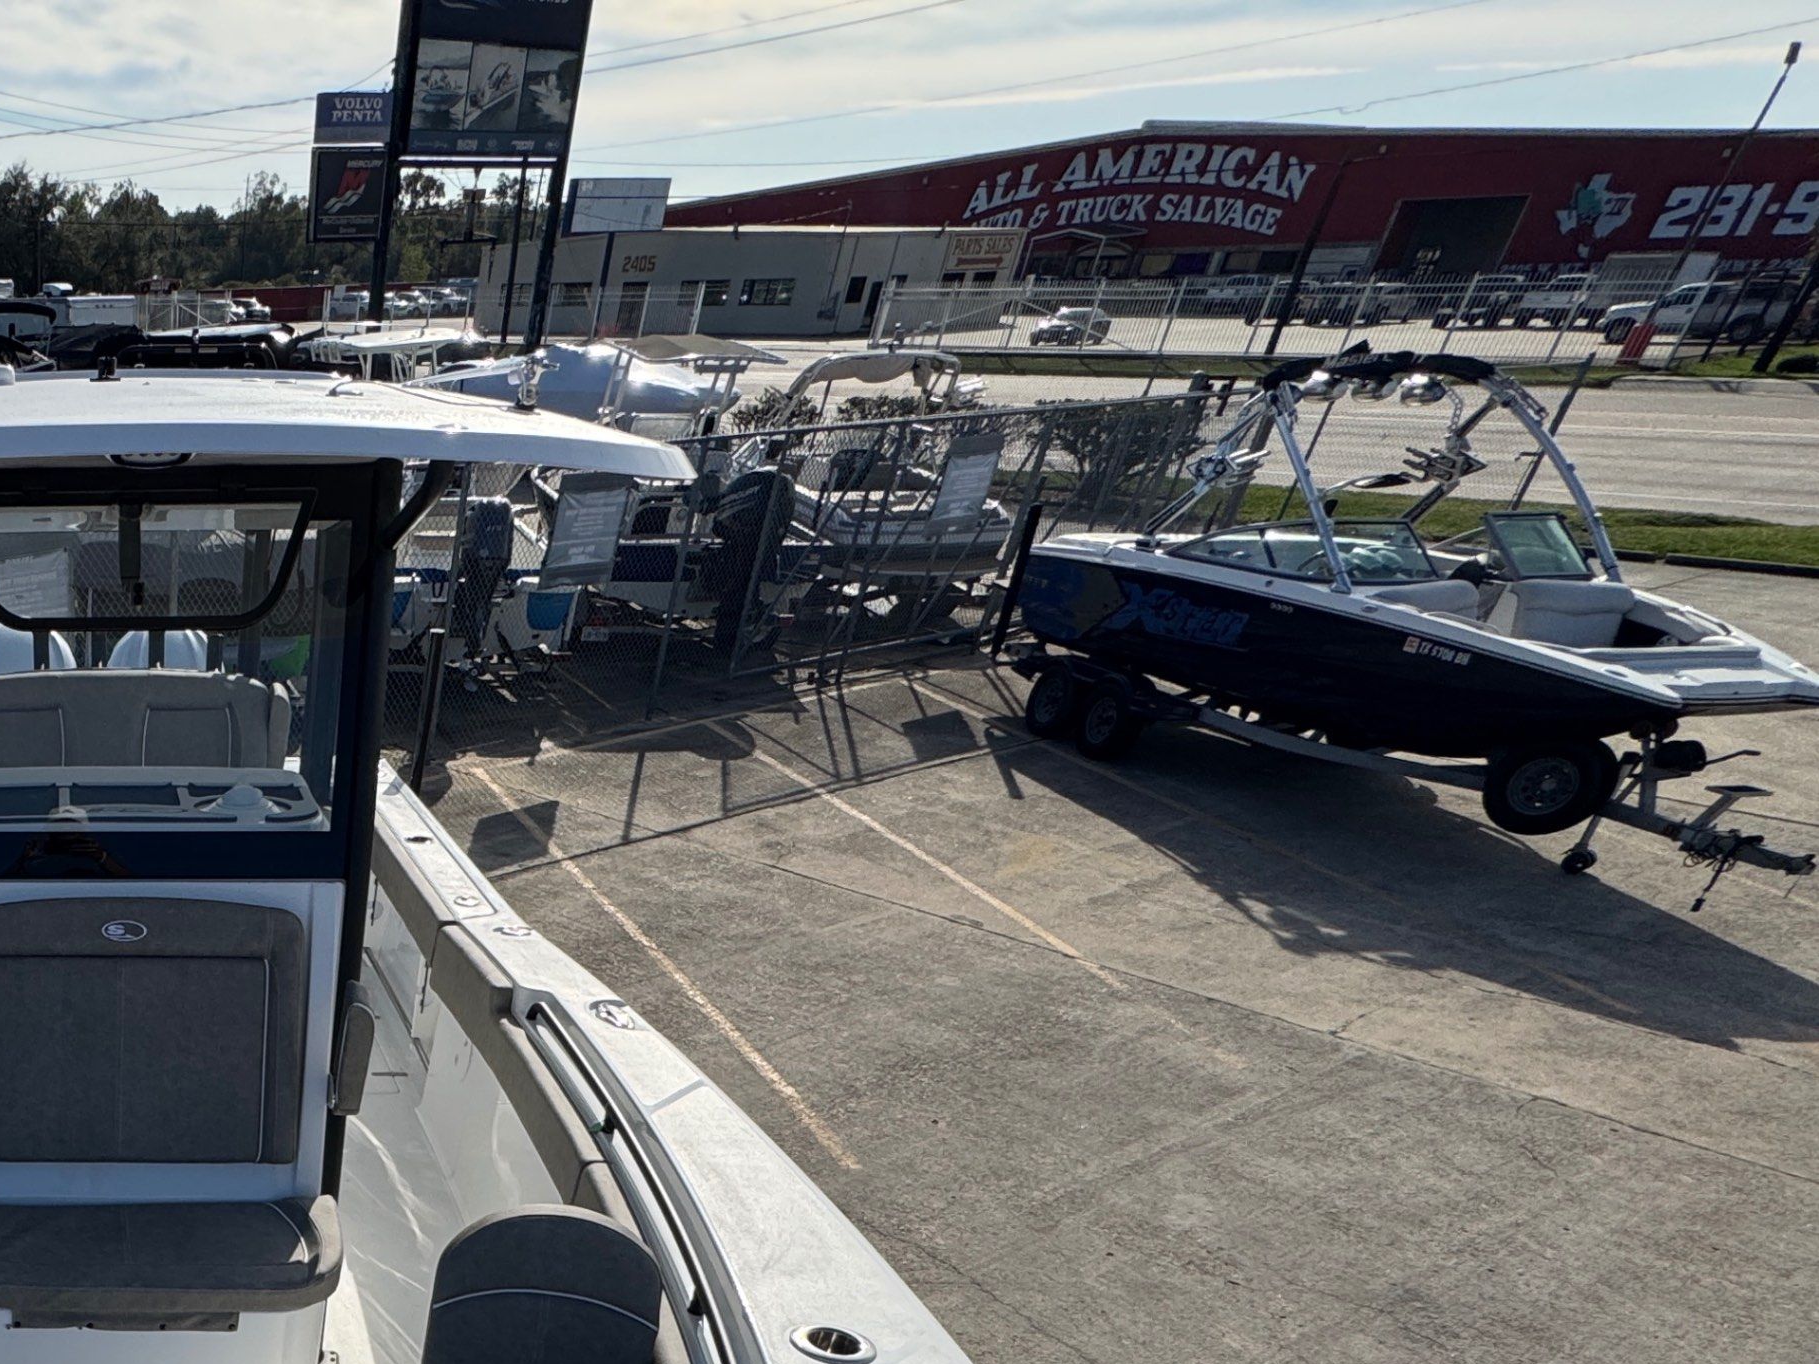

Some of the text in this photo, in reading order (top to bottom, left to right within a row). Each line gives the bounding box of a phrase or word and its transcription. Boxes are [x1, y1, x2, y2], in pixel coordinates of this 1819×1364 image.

[334, 97, 383, 111] VOLVO
[331, 109, 383, 123] PENTA
[347, 159, 384, 169] MERCURY
[962, 142, 1317, 220] ALL AMERICAN
[1028, 203, 1050, 230] &
[1057, 193, 1155, 226] TRUCK
[1154, 193, 1284, 237] SALVAGE
[952, 237, 1015, 256] PARTS SALES
[623, 255, 657, 273] 2405
